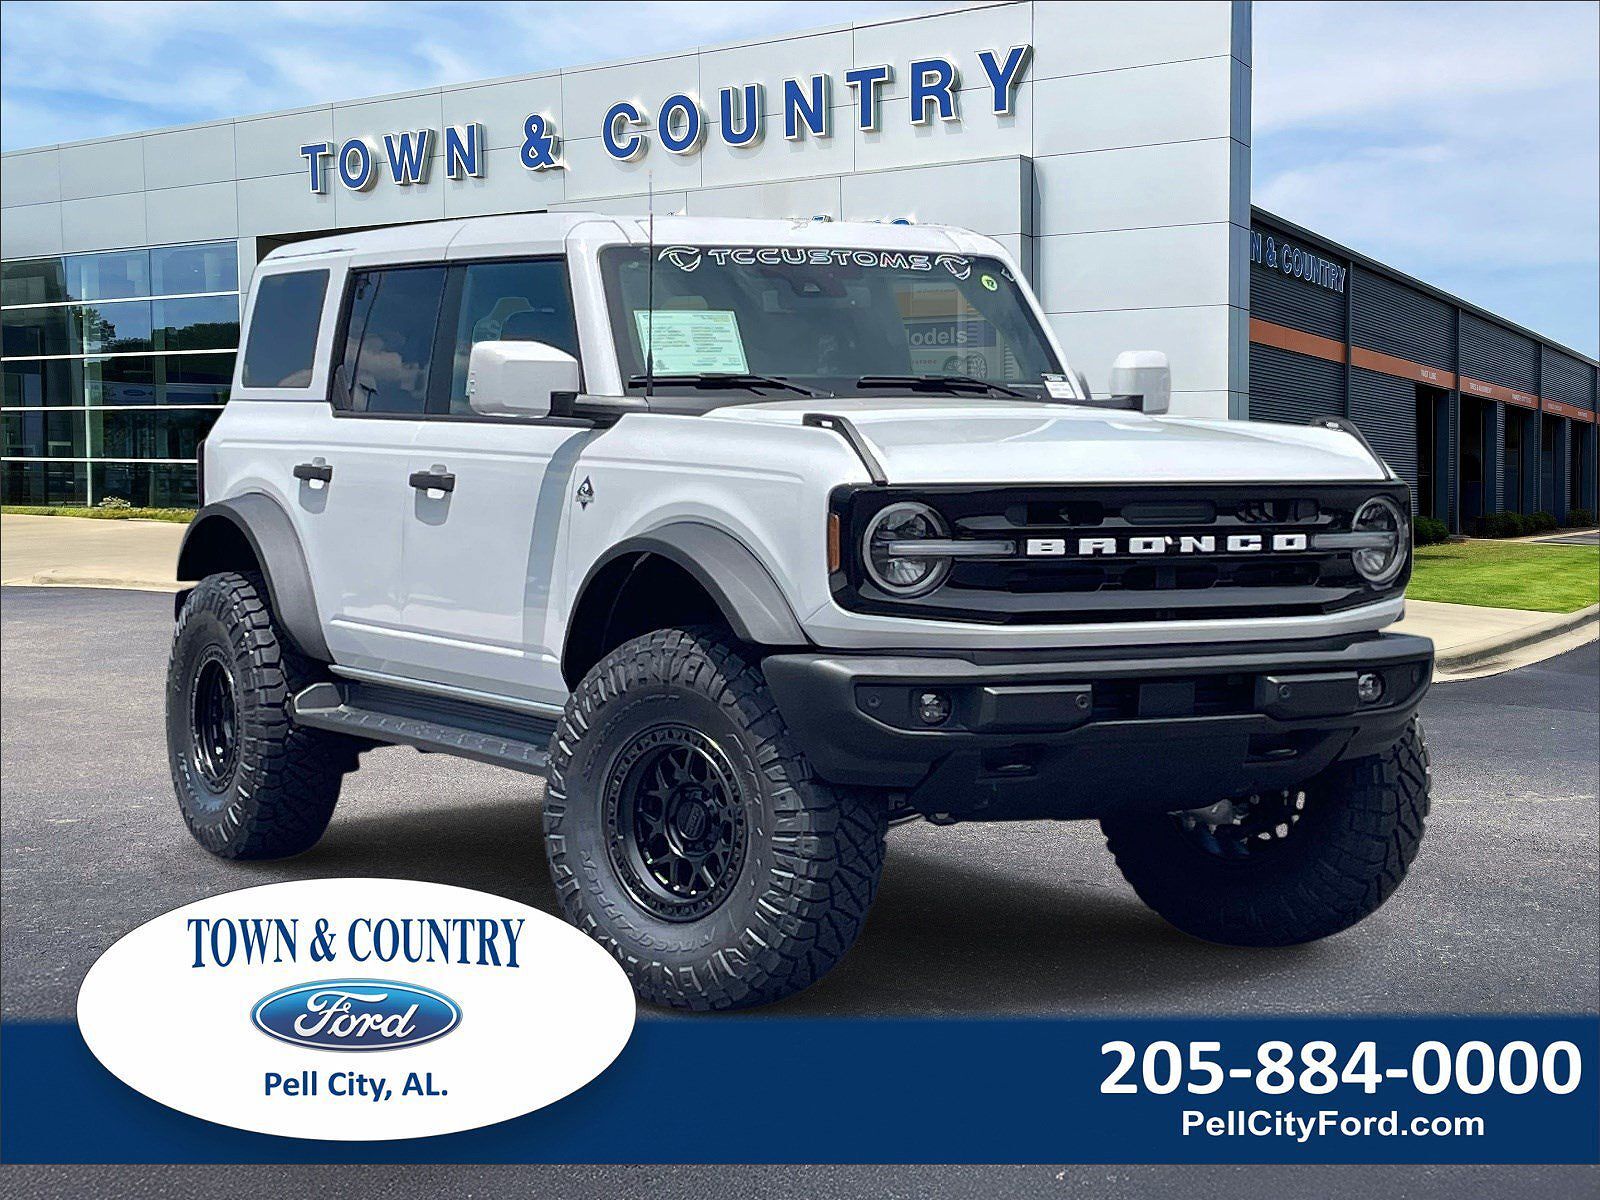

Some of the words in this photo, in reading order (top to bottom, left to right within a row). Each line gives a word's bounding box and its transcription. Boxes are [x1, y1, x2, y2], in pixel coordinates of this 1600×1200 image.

[300, 120, 483, 194] TOWN
[519, 111, 565, 171] &
[601, 44, 1033, 163] COUNTRY
[708, 248, 932, 271] TCCUSTOMS
[1266, 236, 1277, 268] &
[1281, 243, 1346, 293] COUNTRY
[908, 327, 968, 346] odels
[1026, 534, 1307, 555] BRONCO
